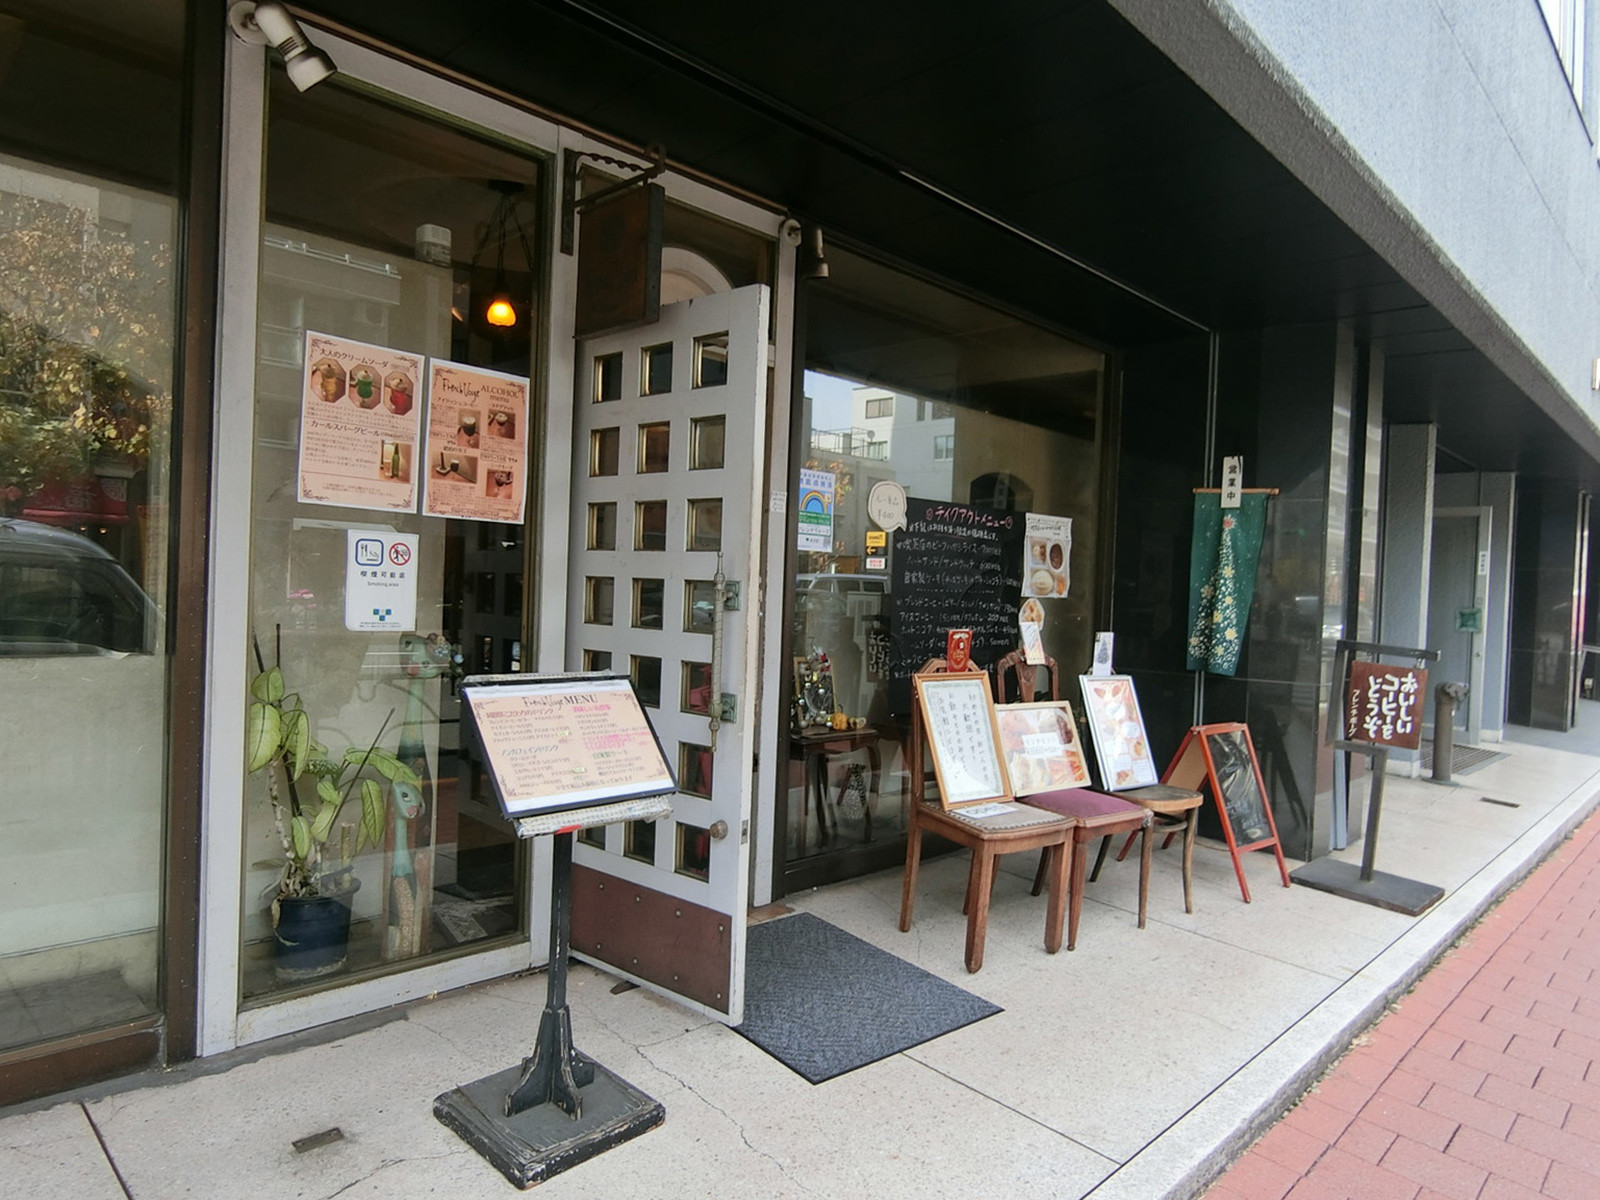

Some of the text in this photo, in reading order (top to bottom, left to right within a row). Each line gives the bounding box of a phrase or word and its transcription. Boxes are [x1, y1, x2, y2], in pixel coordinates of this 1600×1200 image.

[480, 385, 519, 399] ALCOHOL
[1225, 463, 1238, 502] 営業中
[563, 693, 599, 704] MENU
[1362, 675, 1383, 739] どうぞ
[1381, 673, 1400, 740] コーヒーを
[1396, 671, 1418, 734] おいしい
